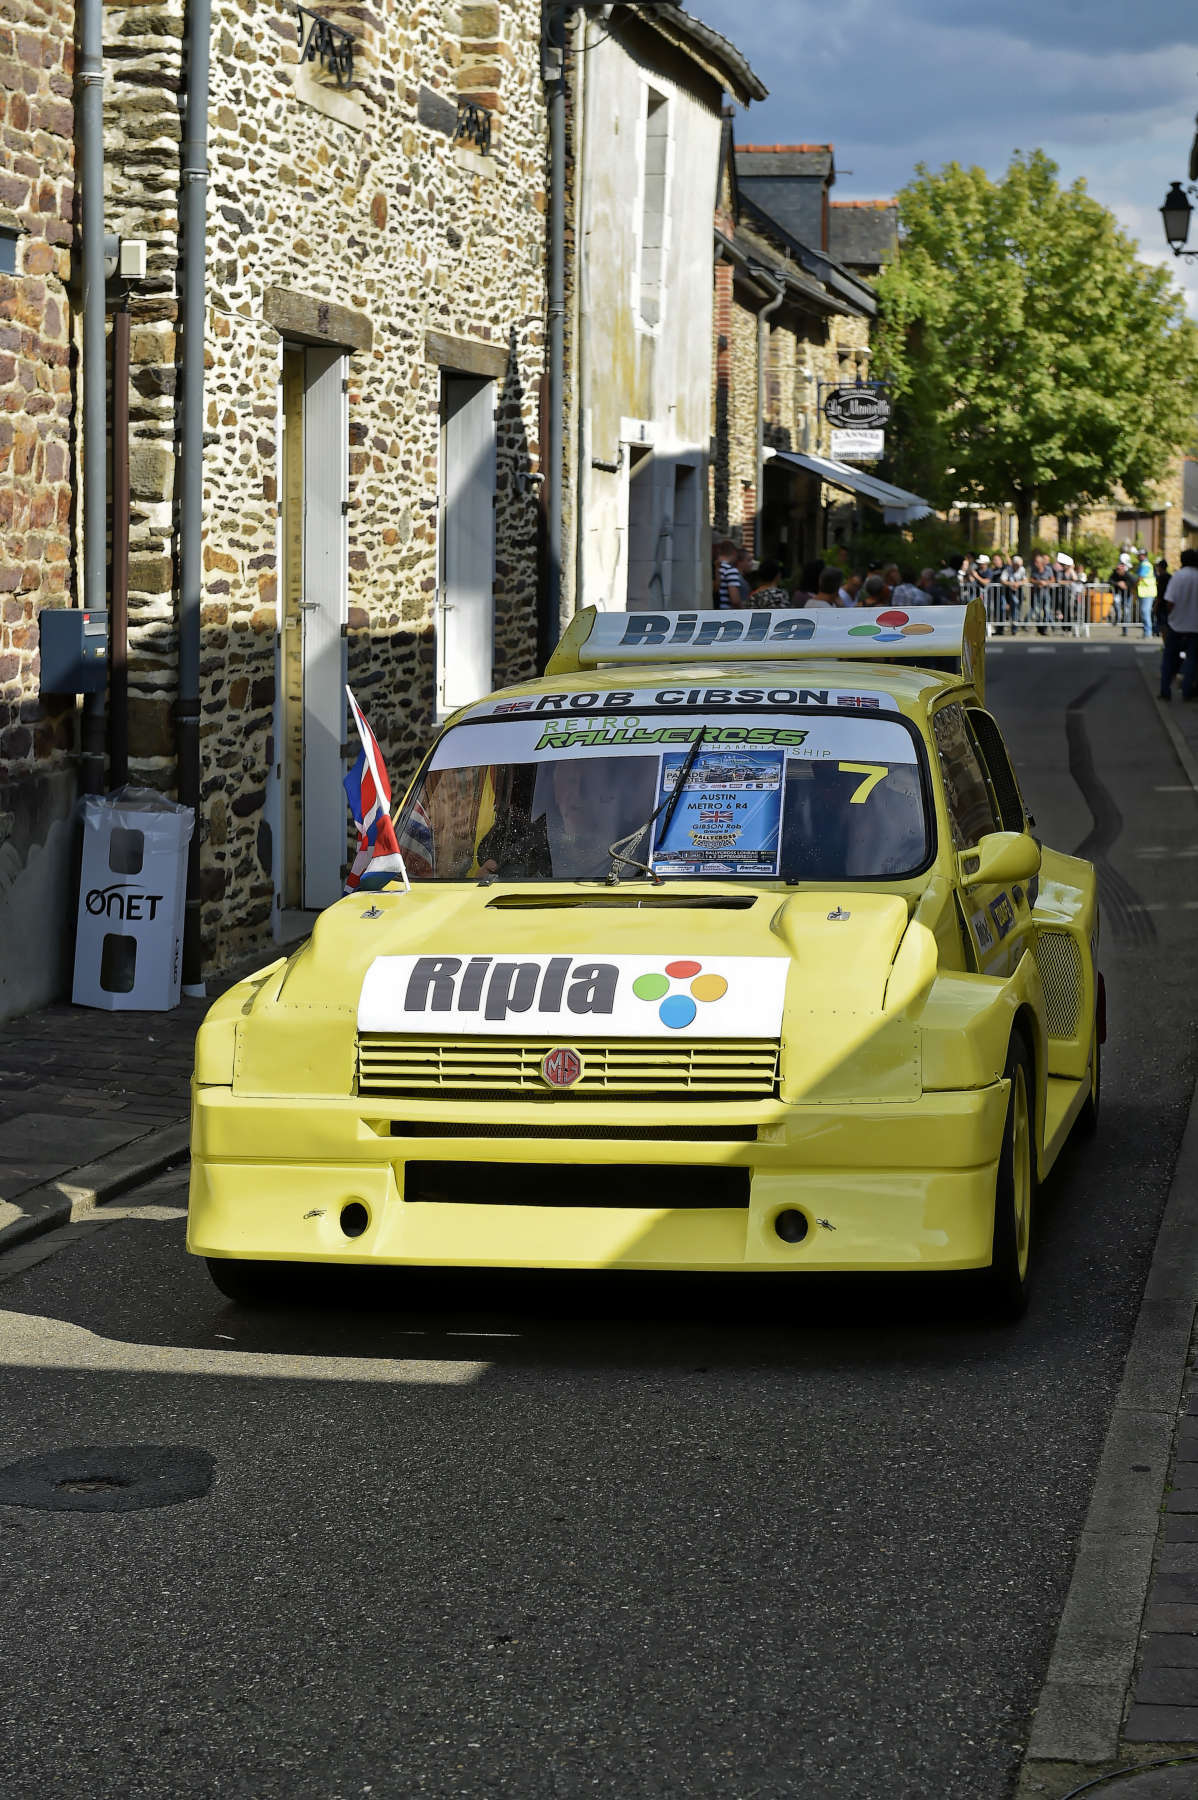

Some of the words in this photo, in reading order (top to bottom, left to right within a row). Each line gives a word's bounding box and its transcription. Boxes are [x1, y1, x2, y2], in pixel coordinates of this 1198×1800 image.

[618, 612, 816, 646] Ripla
[535, 691, 635, 711] ROB
[654, 689, 829, 705] GIBSON
[543, 716, 641, 733] RETRO
[534, 727, 810, 751] RALLYCROSS
[838, 761, 889, 804] 7
[687, 802, 723, 810] METRO
[726, 802, 732, 810] 6
[735, 802, 748, 810] R4
[700, 793, 736, 801] AUSTIN
[403, 956, 620, 1021] Ripla
